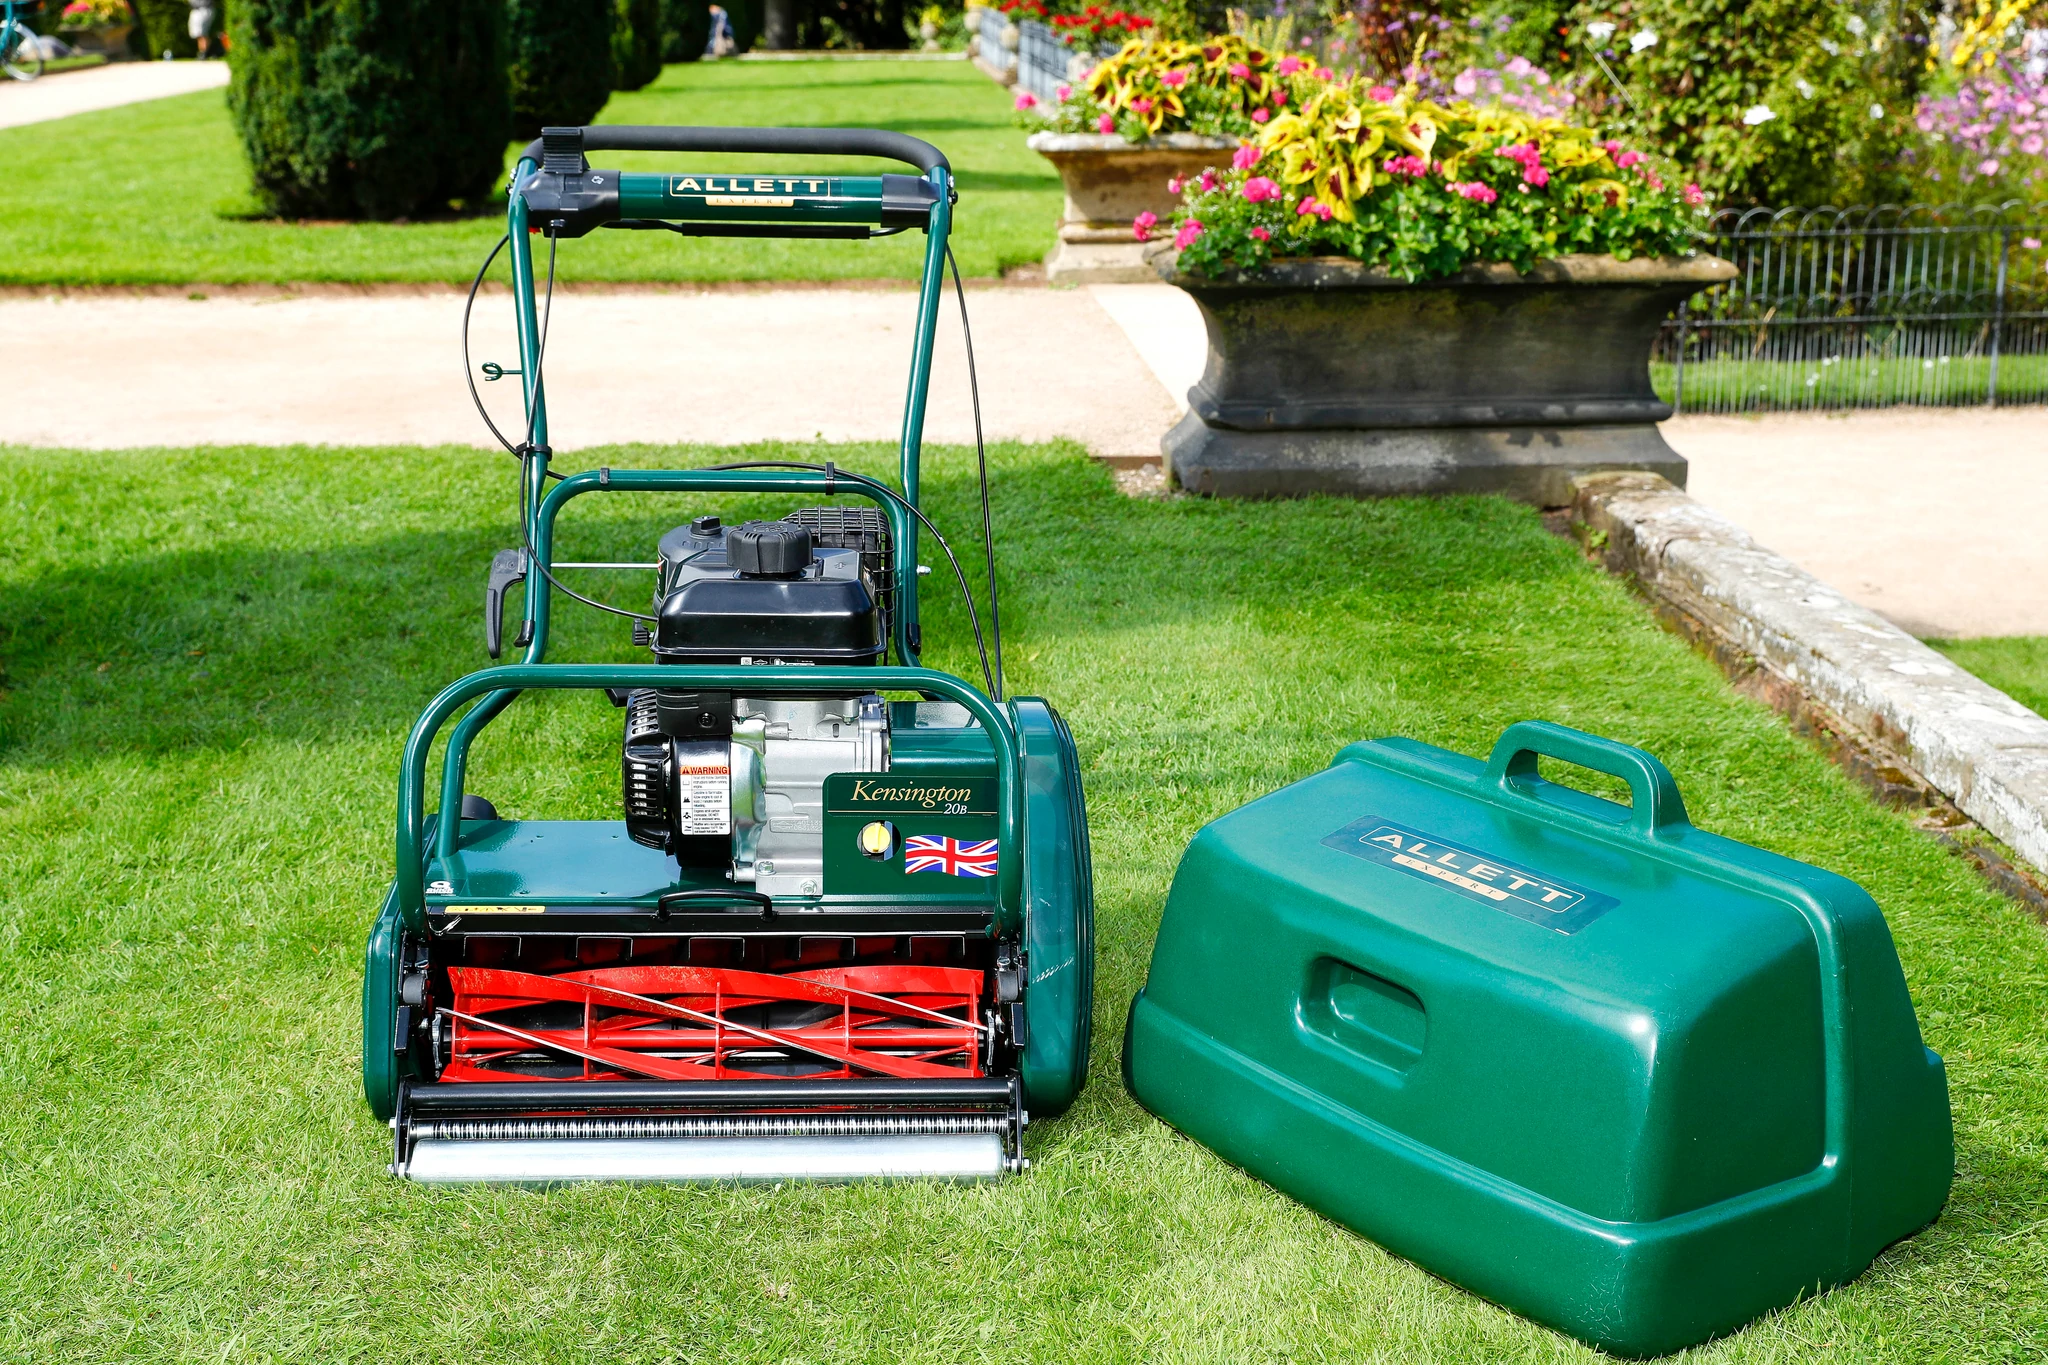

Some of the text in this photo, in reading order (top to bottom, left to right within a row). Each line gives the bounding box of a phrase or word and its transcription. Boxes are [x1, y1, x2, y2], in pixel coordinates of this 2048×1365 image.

[676, 178, 825, 192] ALLETT
[691, 766, 728, 775] WARNING
[850, 780, 972, 809] Kensington
[943, 803, 968, 815] 20B
[1372, 834, 1573, 903] ALLETT
[1405, 858, 1498, 895] EXPERT
